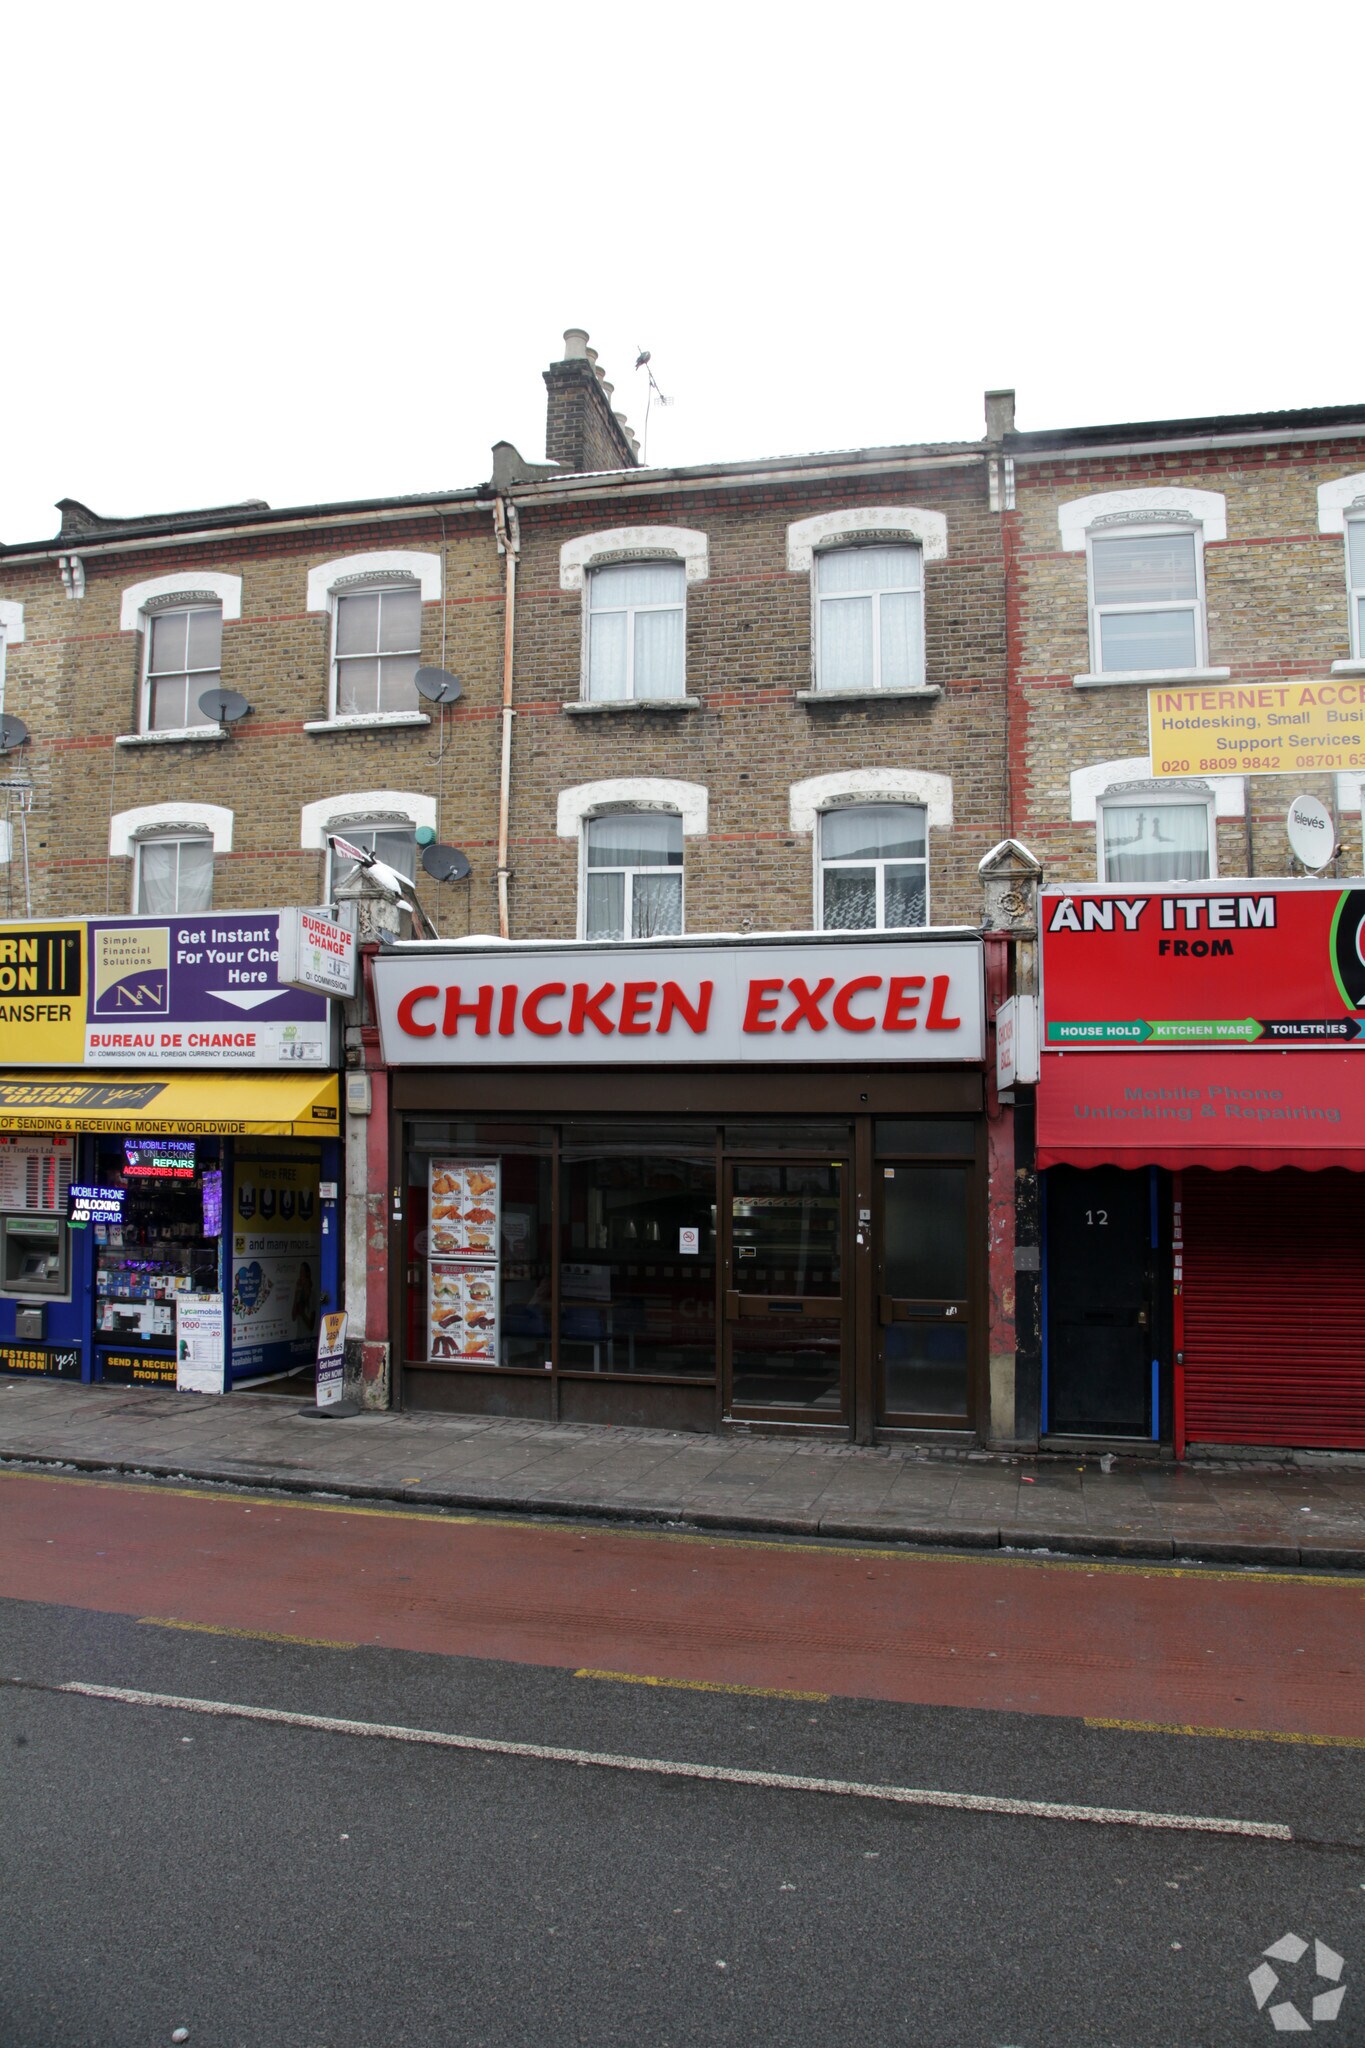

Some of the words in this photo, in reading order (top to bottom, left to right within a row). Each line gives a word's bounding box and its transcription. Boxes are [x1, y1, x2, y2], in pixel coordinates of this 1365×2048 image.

[1157, 688, 1290, 713] INTERNET
[1162, 715, 1261, 730] Hotdesking,
[1267, 712, 1310, 726] Small
[1216, 735, 1283, 752] Support
[1288, 733, 1361, 748] Services
[1161, 760, 1190, 773] 020
[1199, 758, 1237, 771] 8809
[1242, 756, 1281, 769] 9842
[1295, 755, 1343, 768] 08701
[1293, 810, 1325, 830] Televés
[1048, 898, 1149, 932] ANY
[1162, 896, 1276, 930] ITEM
[177, 930, 206, 944] Get
[211, 928, 270, 943] Instant
[302, 915, 338, 940] BUREAU
[340, 931, 352, 945] DE
[103, 937, 138, 946] Simple
[309, 933, 344, 956] CHANGE
[1158, 939, 1234, 957] FROM
[103, 946, 150, 955] Financial
[177, 950, 203, 964] For
[206, 949, 244, 964] Your
[103, 958, 152, 966] Solutions
[228, 969, 267, 983] Here
[314, 974, 347, 991] COMMISSION
[397, 980, 714, 1037] CHICKEN
[742, 975, 961, 1033] EXCEL
[1060, 1026, 1103, 1036] HOUSE
[1106, 1026, 1141, 1036] HOLD
[1157, 1025, 1212, 1036] KITCHEN
[1216, 1025, 1253, 1035] WARE
[1271, 1024, 1348, 1034] TOILETRIES
[90, 1034, 155, 1047] BUREAU
[161, 1034, 182, 1047] DE
[188, 1033, 256, 1047] CHANGE
[4, 1095, 79, 1105] UNION
[1124, 1087, 1201, 1101] Mobile
[1208, 1086, 1283, 1101] Phone
[1074, 1104, 1193, 1121] Unlocking
[1200, 1104, 1217, 1118] &
[1224, 1104, 1342, 1122] Repairing
[1, 1117, 15, 1128] OF
[17, 1118, 62, 1129] SENDING
[65, 1120, 72, 1130] &
[75, 1120, 131, 1131] RECEIVING
[135, 1121, 174, 1132] MONEY
[177, 1122, 246, 1133] WORLDWIDE
[124, 1141, 138, 1149] ALL
[139, 1141, 167, 1150] MOBILE
[168, 1142, 195, 1151] PHONE
[144, 1150, 195, 1159] UNLOCKING
[153, 1159, 194, 1168] REPAIRS
[123, 1166, 173, 1177] ACCESSORIES
[174, 1168, 194, 1178] HERE
[71, 1186, 98, 1198] MOBILE
[100, 1188, 125, 1200] PHONE
[75, 1199, 120, 1211] UNLOCKING
[71, 1210, 90, 1221] AND
[92, 1211, 122, 1223] REPAIR
[1085, 1210, 1109, 1225] 12
[249, 1237, 265, 1250] and
[266, 1240, 288, 1253] many
[180, 1307, 222, 1316] Lycamobile
[182, 1321, 200, 1329] 1000
[329, 1316, 339, 1327] We
[8, 1359, 45, 1370] UNION
[55, 1351, 77, 1370] yes!
[108, 1357, 131, 1367] SEND
[133, 1359, 140, 1367] &
[133, 1370, 159, 1380] FROM
